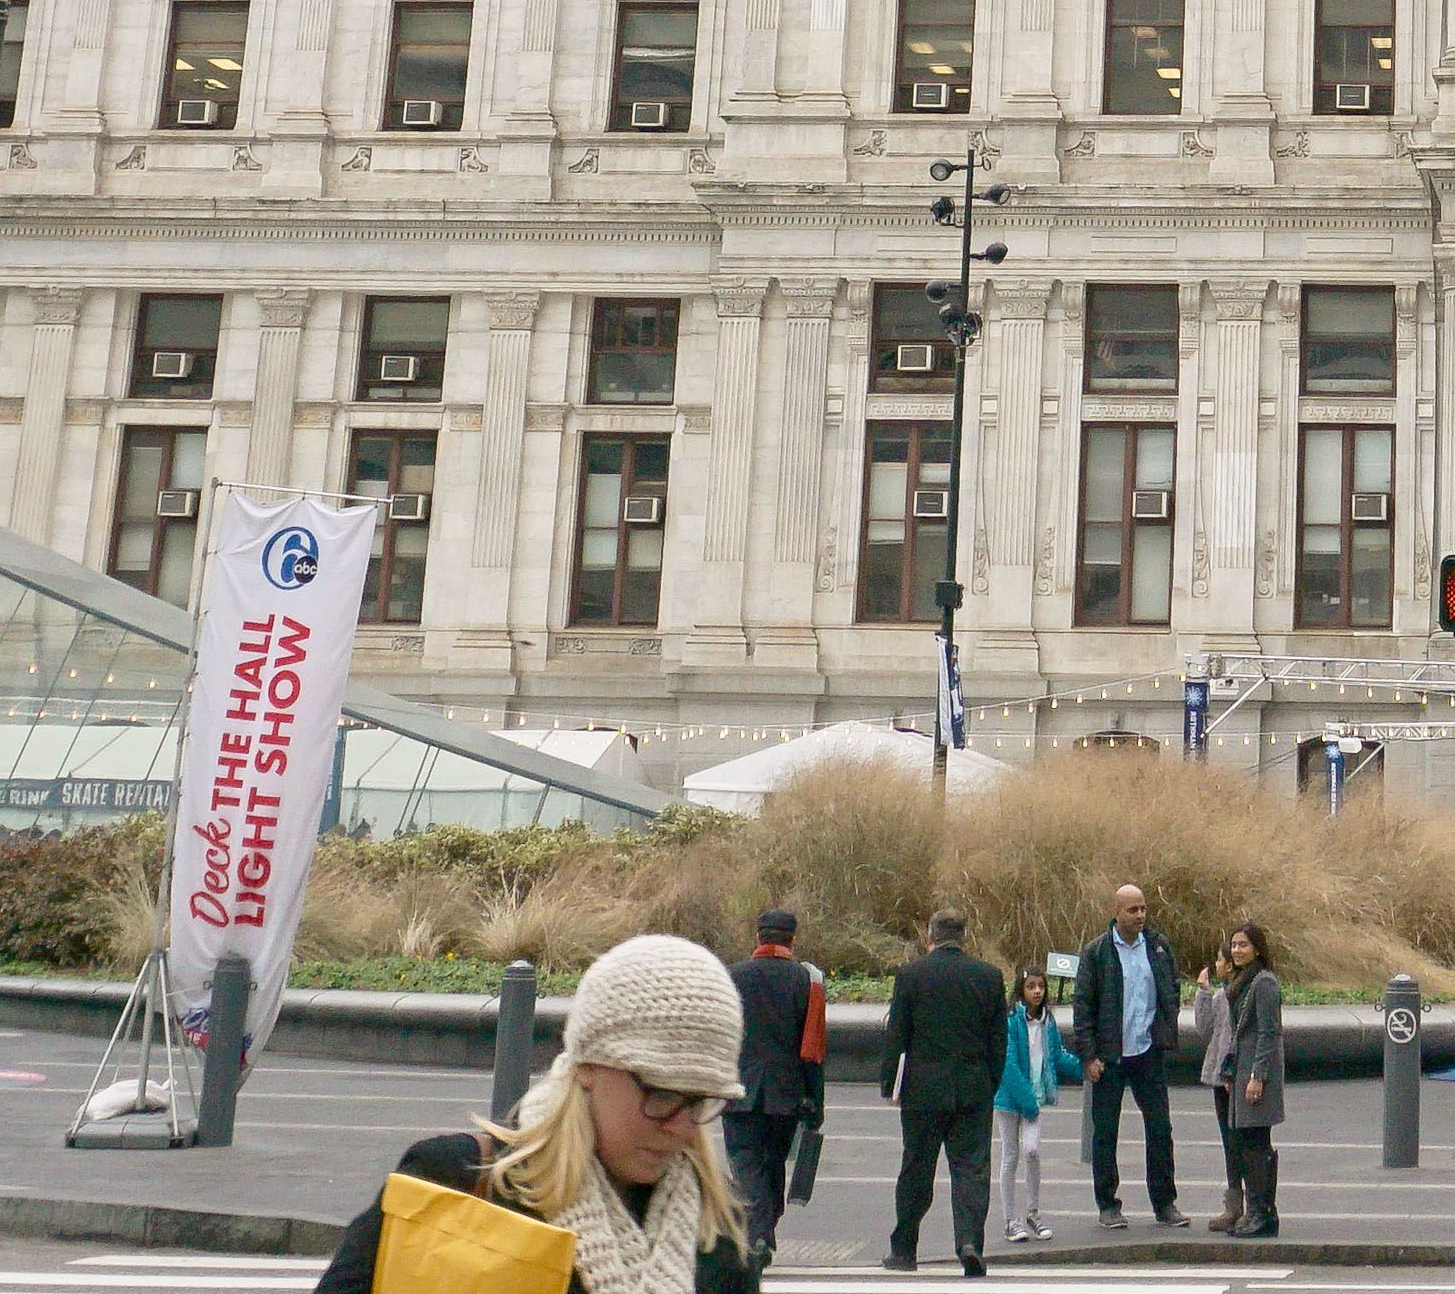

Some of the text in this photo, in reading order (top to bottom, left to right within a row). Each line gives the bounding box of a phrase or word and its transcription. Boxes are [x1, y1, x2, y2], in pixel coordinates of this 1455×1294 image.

[293, 561, 318, 577] abc
[10, 789, 49, 805] RINK
[62, 783, 107, 806] SKATE
[113, 784, 171, 807] RENTAL
[189, 613, 276, 928] Deck THE HALL
[235, 616, 311, 928] LIGHT SHOW
